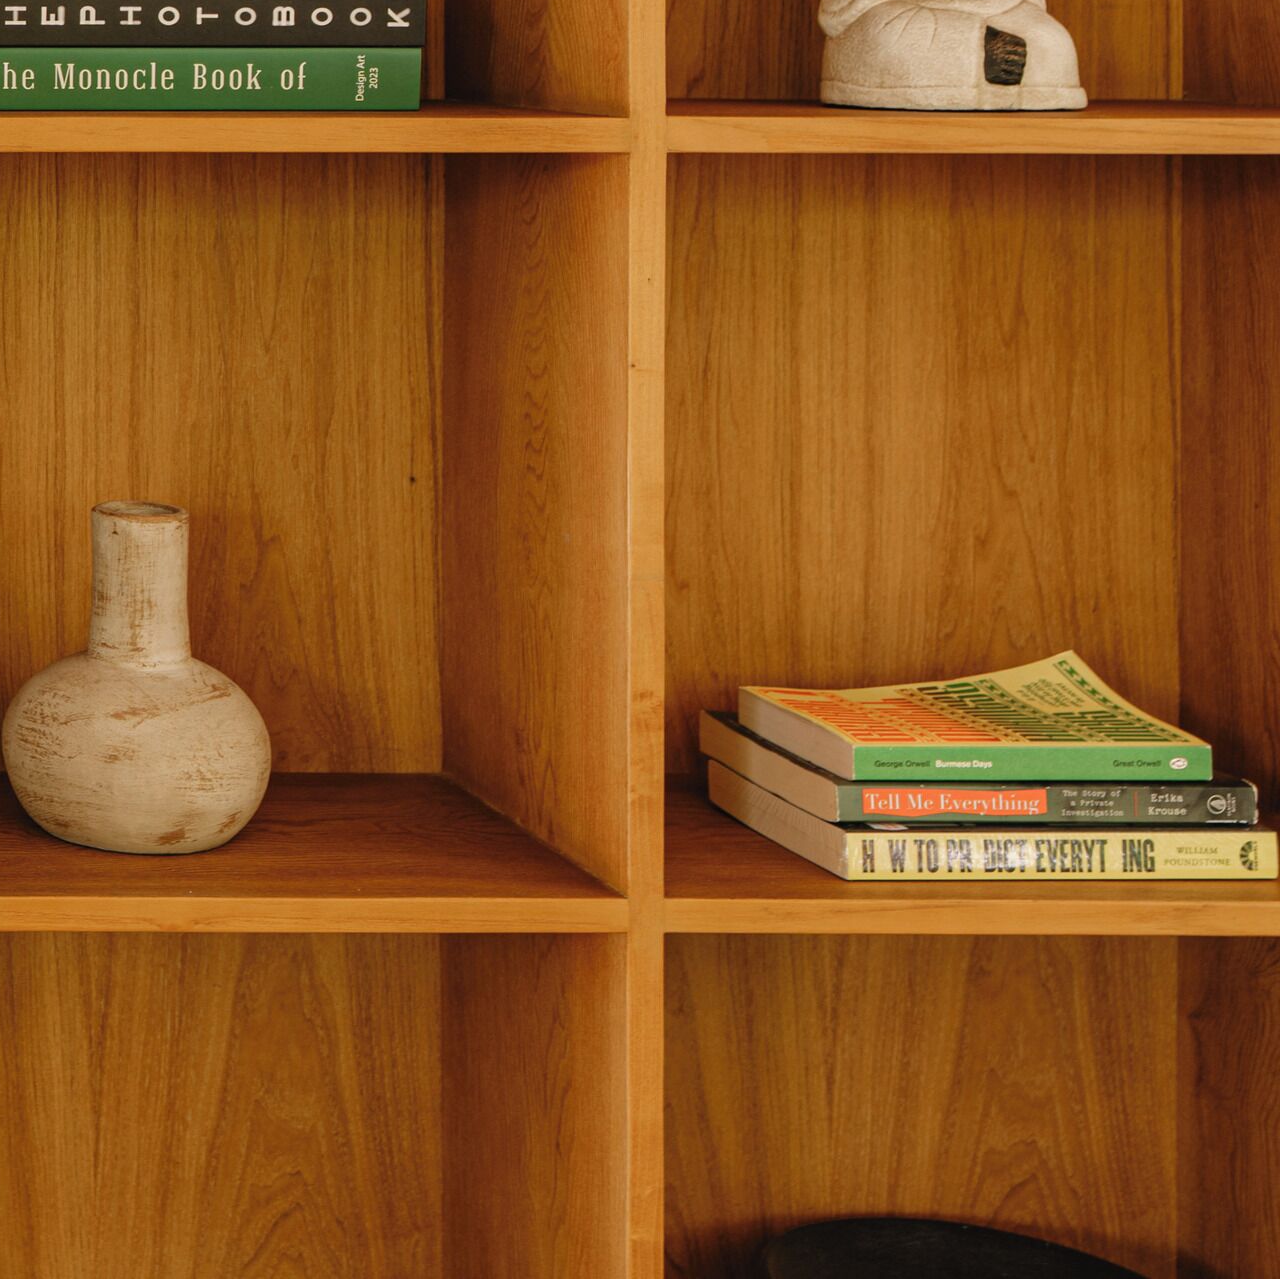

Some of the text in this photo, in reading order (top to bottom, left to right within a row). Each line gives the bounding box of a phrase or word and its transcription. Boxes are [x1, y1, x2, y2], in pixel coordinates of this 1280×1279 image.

[53, 62, 175, 91] Monocle
[192, 62, 262, 91] Book
[280, 61, 308, 91] of
[355, 55, 367, 102] Design Art
[368, 67, 379, 89] 2023
[874, 759, 993, 769] George Orwell Burmese Days
[1112, 759, 1162, 768] Great Orwell
[1061, 789, 1121, 798] The Story of
[1151, 793, 1184, 803] Erika
[865, 793, 1041, 816] Tell Me Everything
[1080, 799, 1115, 807] Private
[1061, 809, 1124, 818] Investigation
[1148, 806, 1188, 816] Krouse
[1176, 846, 1219, 855] WILLIAM
[914, 839, 940, 873] TO
[1164, 857, 1231, 867] POUNDSTONE
